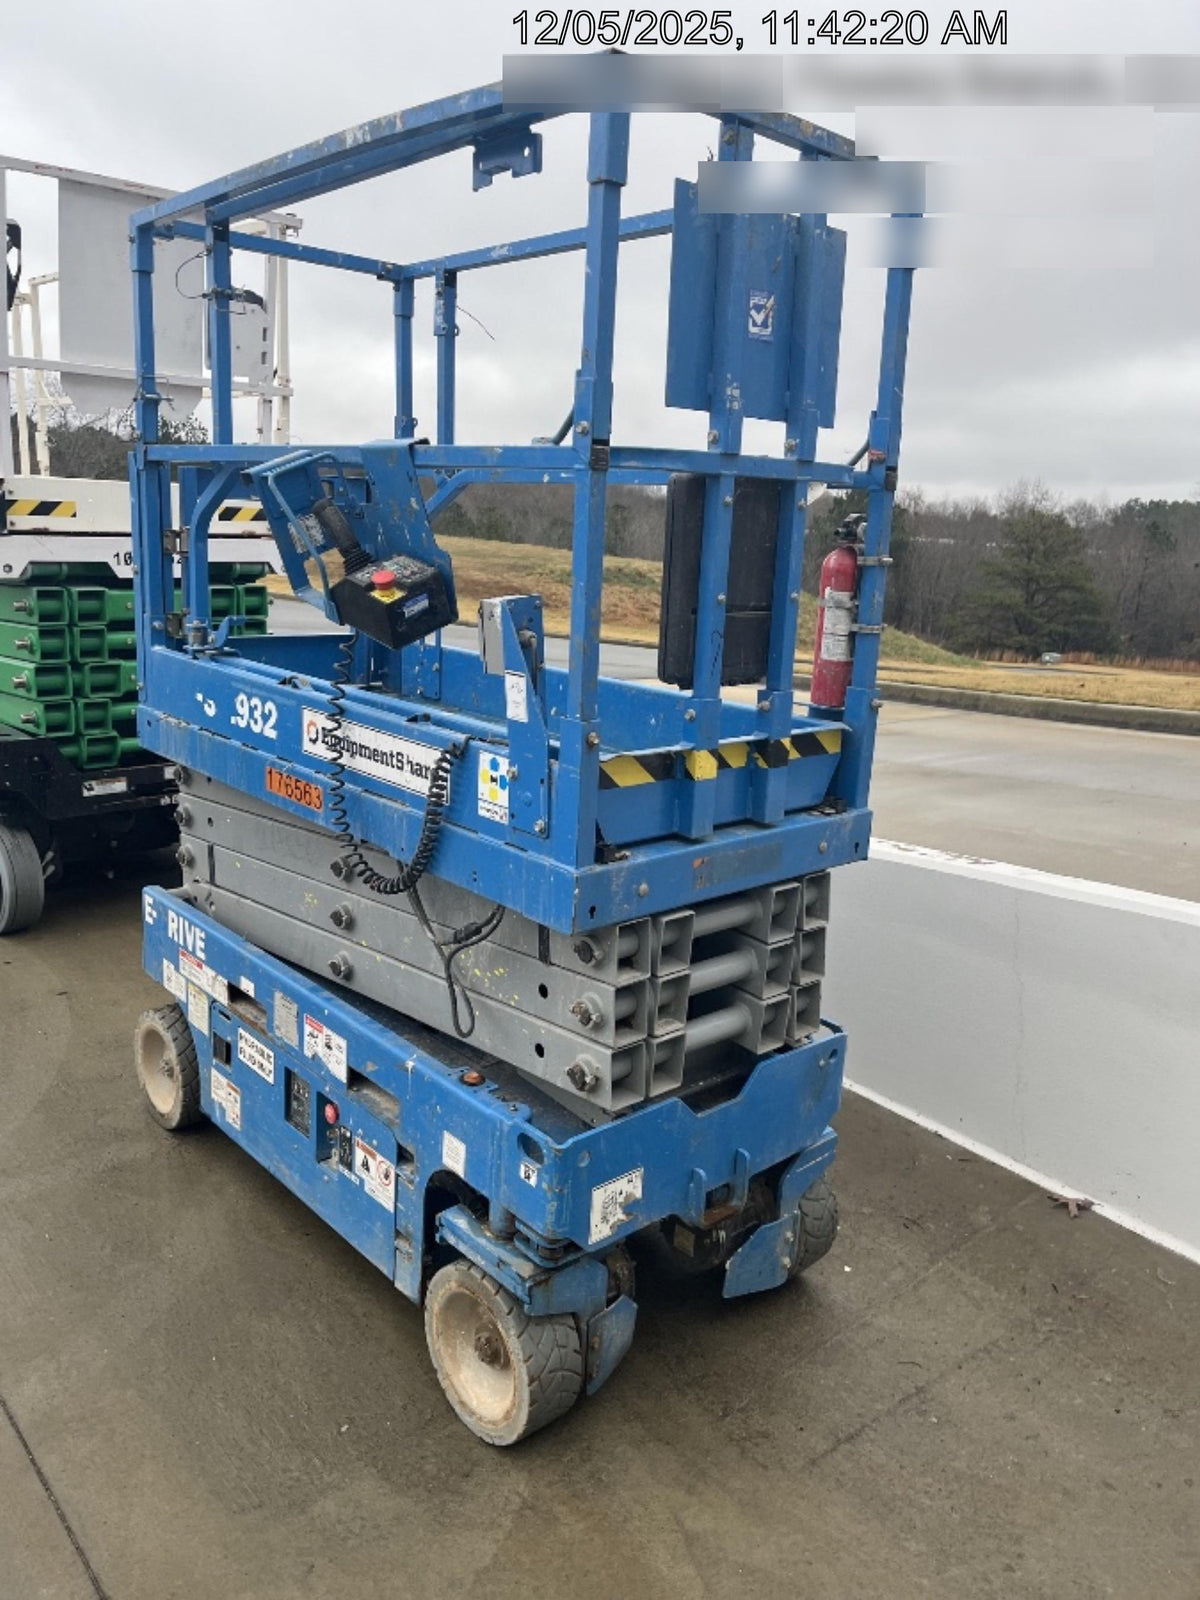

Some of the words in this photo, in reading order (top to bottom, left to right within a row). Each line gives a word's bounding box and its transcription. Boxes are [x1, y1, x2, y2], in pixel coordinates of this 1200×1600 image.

[230, 691, 278, 740] 932
[321, 726, 436, 782] EuipmentShar
[267, 767, 323, 811] 176563
